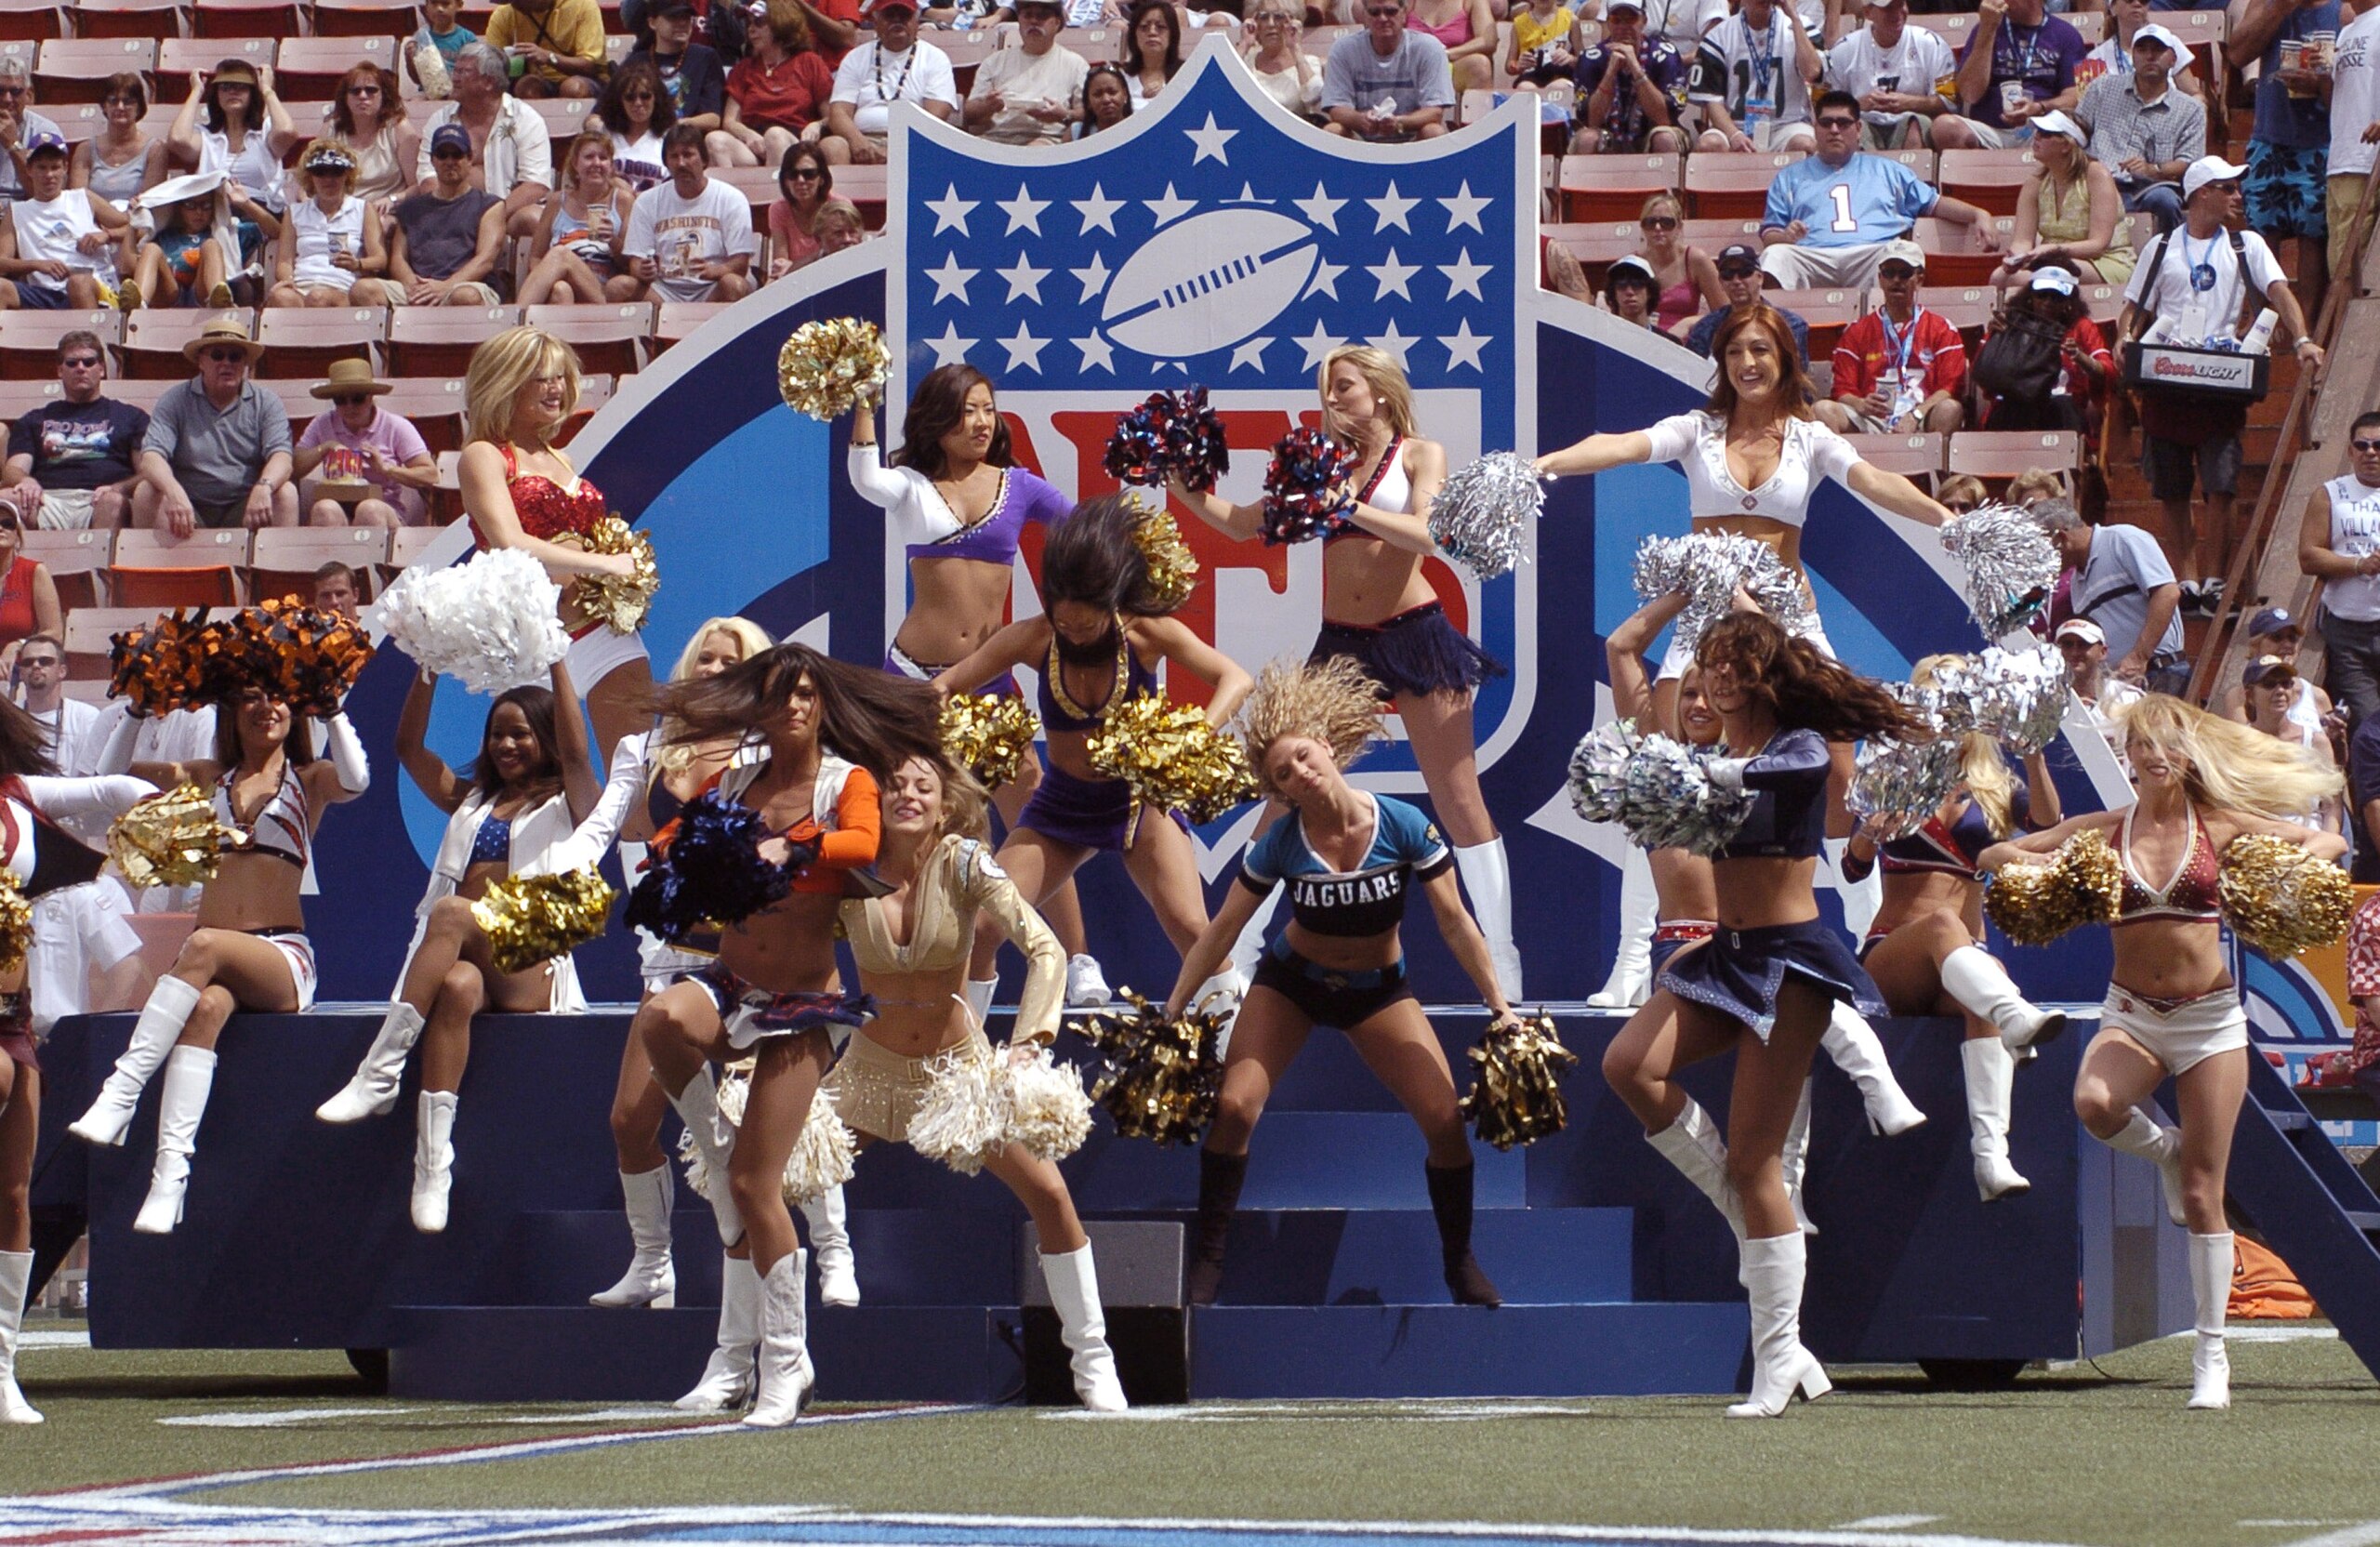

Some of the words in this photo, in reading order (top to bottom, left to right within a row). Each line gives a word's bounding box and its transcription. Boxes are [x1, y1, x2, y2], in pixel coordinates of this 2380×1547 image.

[1830, 184, 1858, 232] 1
[654, 216, 722, 234] WASHINGTO
[2154, 357, 2196, 377] Coors
[2194, 364, 2242, 380] LIGHT
[41, 419, 73, 437] PRO
[997, 409, 1469, 718] NF
[1293, 870, 1401, 907] JAGUARS
